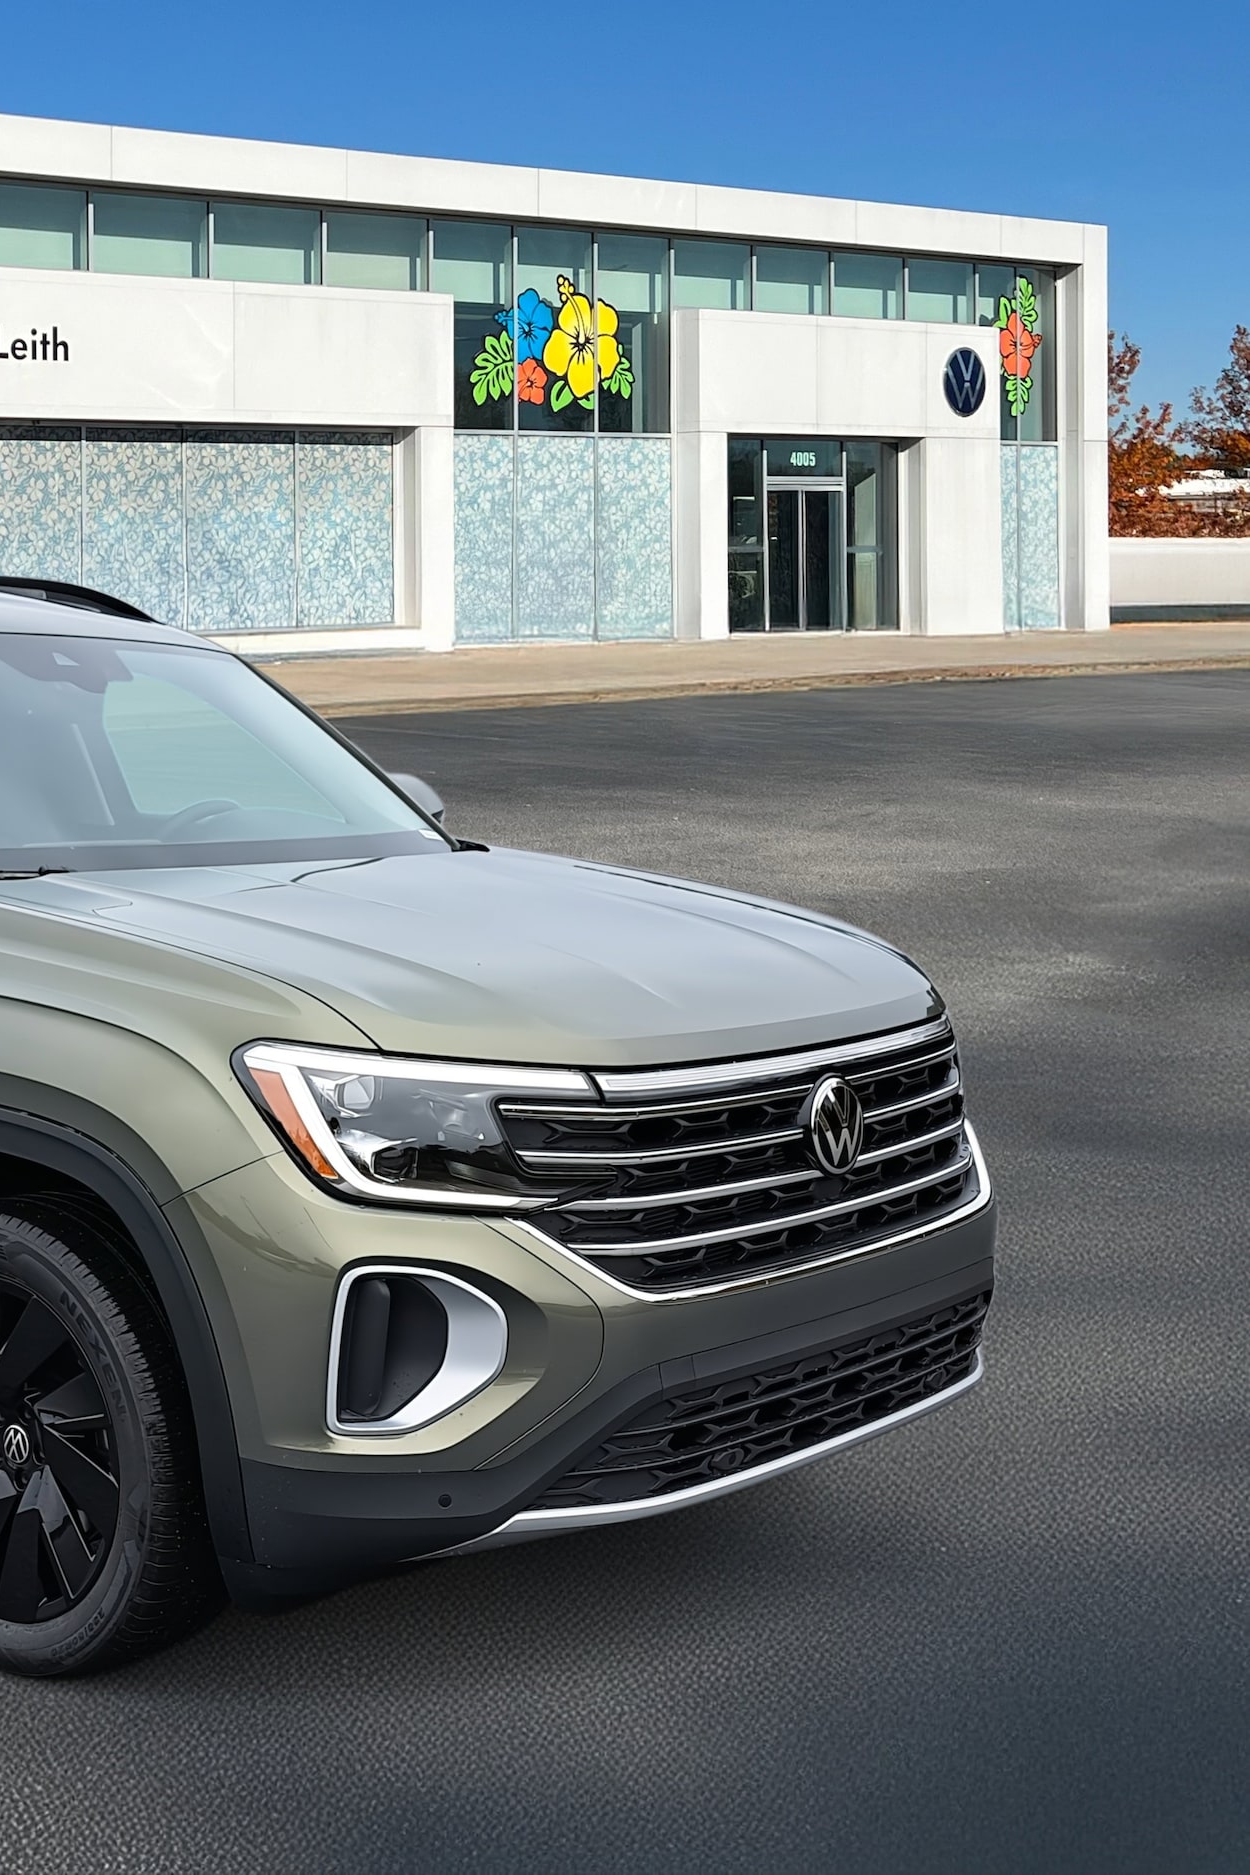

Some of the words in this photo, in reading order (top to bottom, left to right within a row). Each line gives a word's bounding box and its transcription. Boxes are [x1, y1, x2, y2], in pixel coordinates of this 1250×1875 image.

[946, 350, 984, 410] VW
[790, 451, 816, 467] 4005
[815, 1082, 862, 1168] VW
[59, 1291, 127, 1416] NEXEN
[4, 1428, 27, 1462] VW
